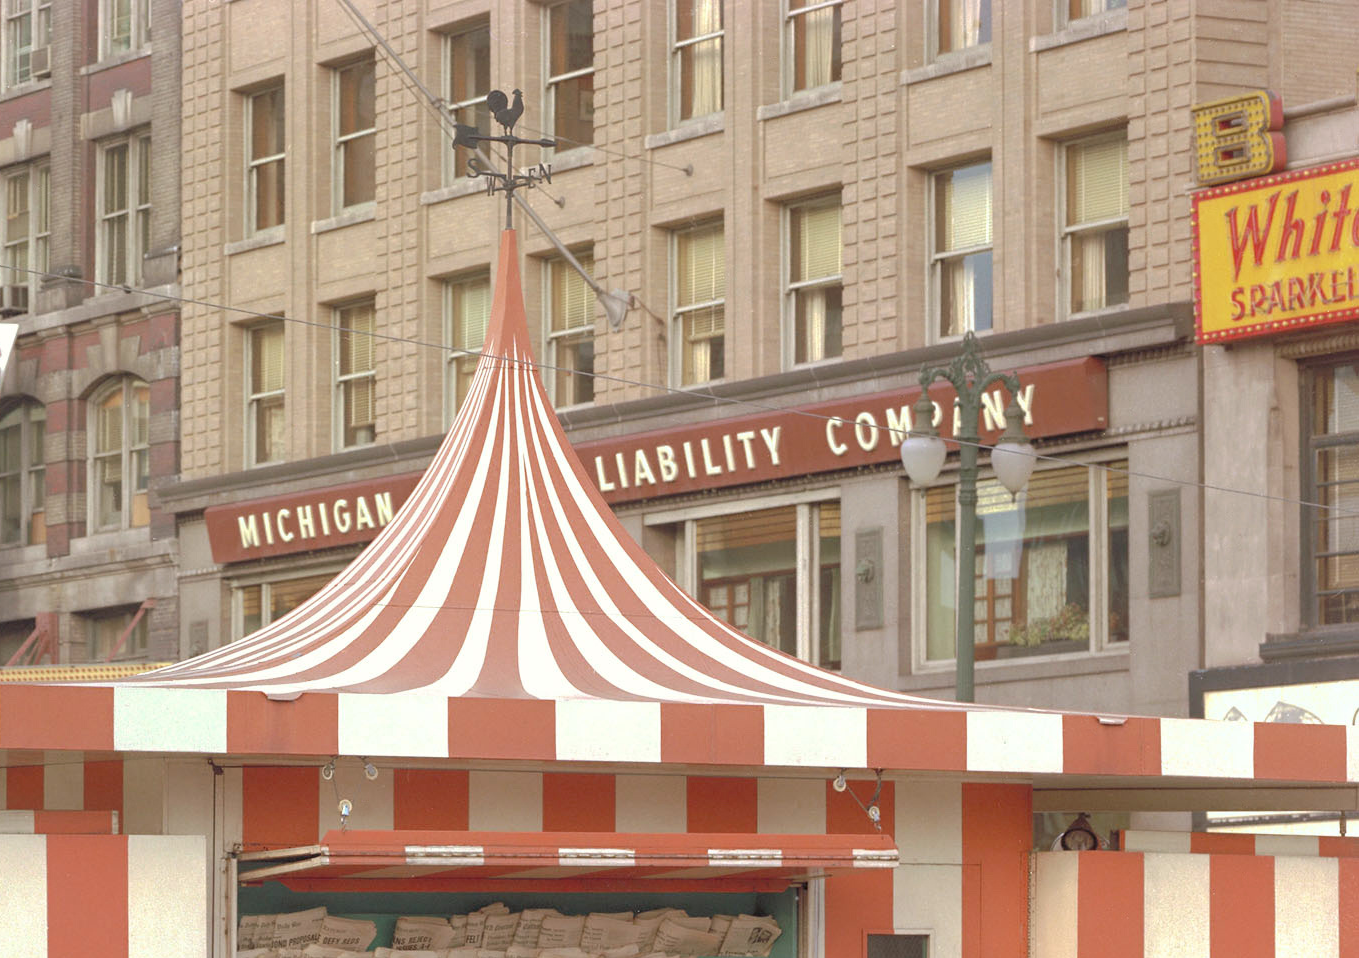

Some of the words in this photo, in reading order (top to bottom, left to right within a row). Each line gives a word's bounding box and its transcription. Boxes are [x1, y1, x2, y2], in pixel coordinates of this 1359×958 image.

[1191, 90, 1286, 188] B
[238, 492, 394, 549] MICHIGAN
[594, 426, 782, 492] LIABILITY
